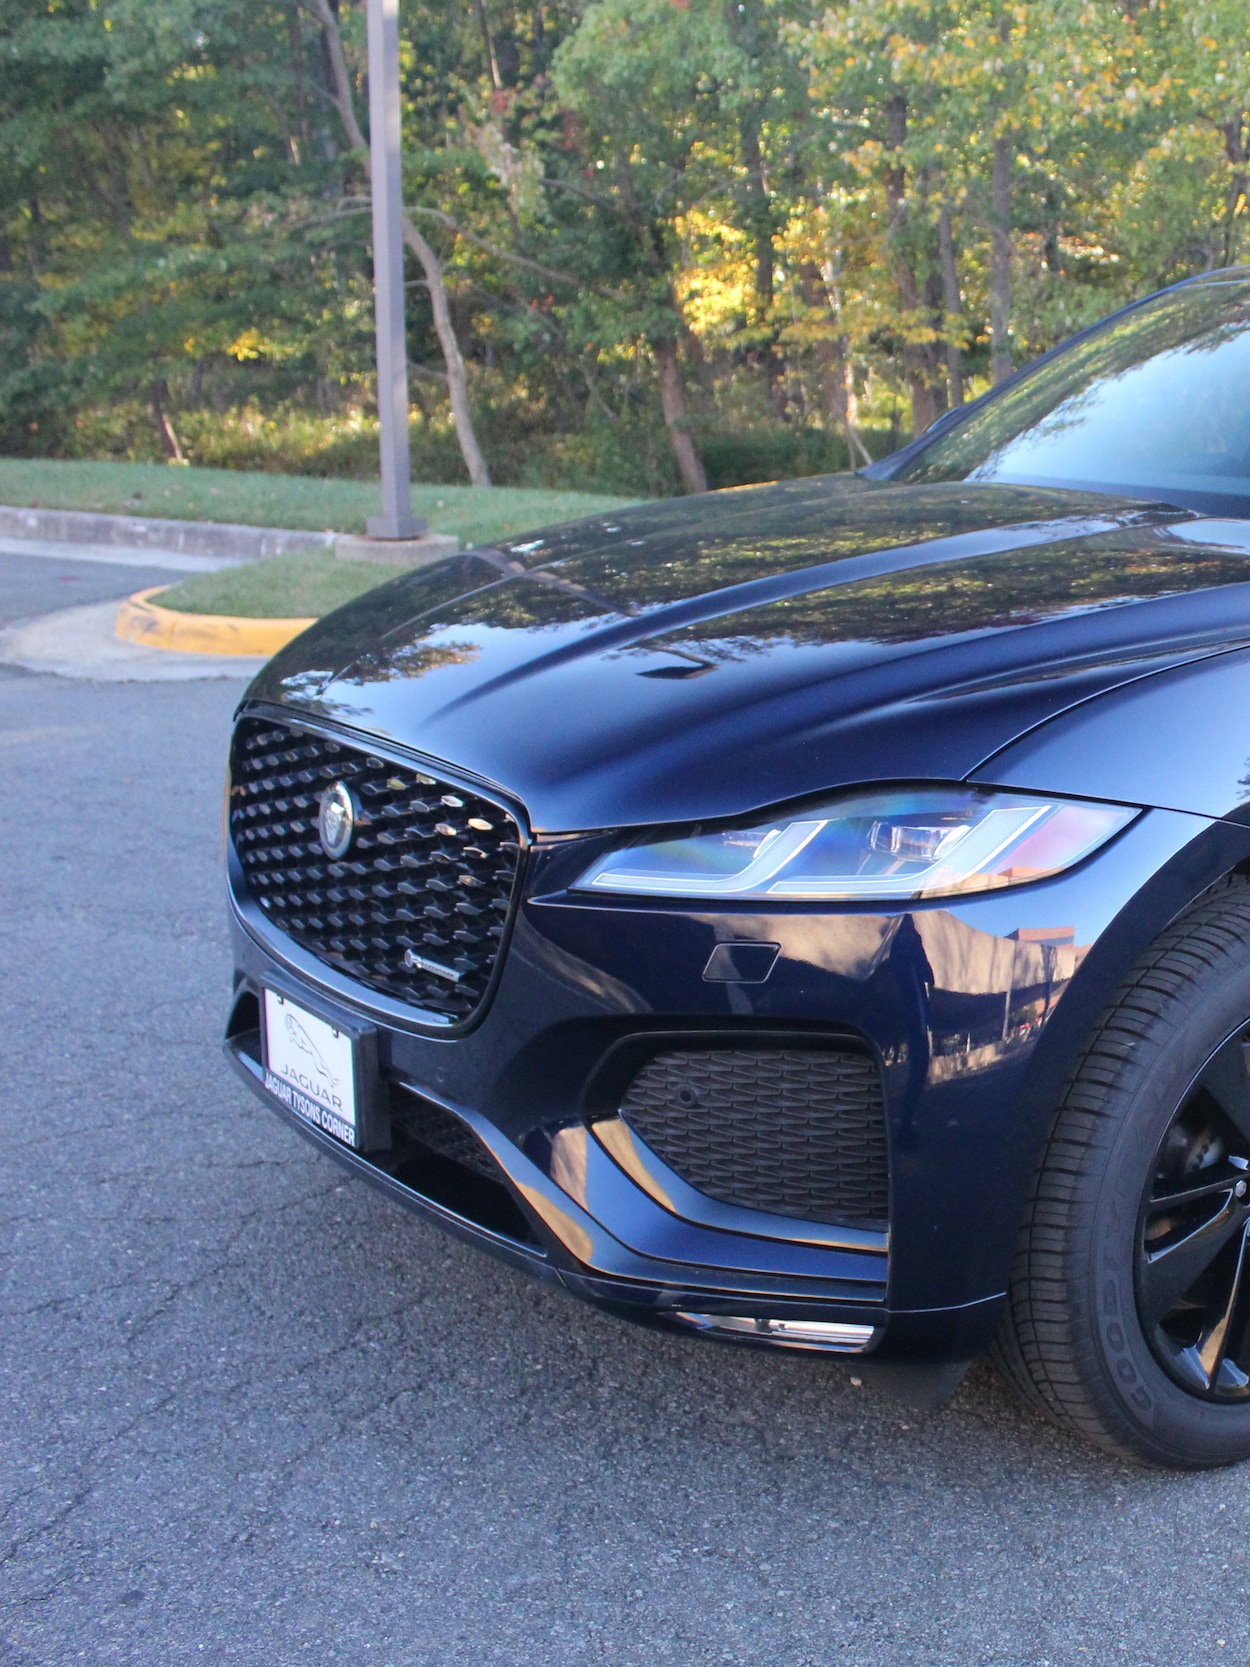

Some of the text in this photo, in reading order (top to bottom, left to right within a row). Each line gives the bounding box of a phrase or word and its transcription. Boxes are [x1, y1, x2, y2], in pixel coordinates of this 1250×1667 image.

[265, 1073, 355, 1146] JAGUAR TYSONS CORNER
[281, 1064, 343, 1112] JAGUAR
